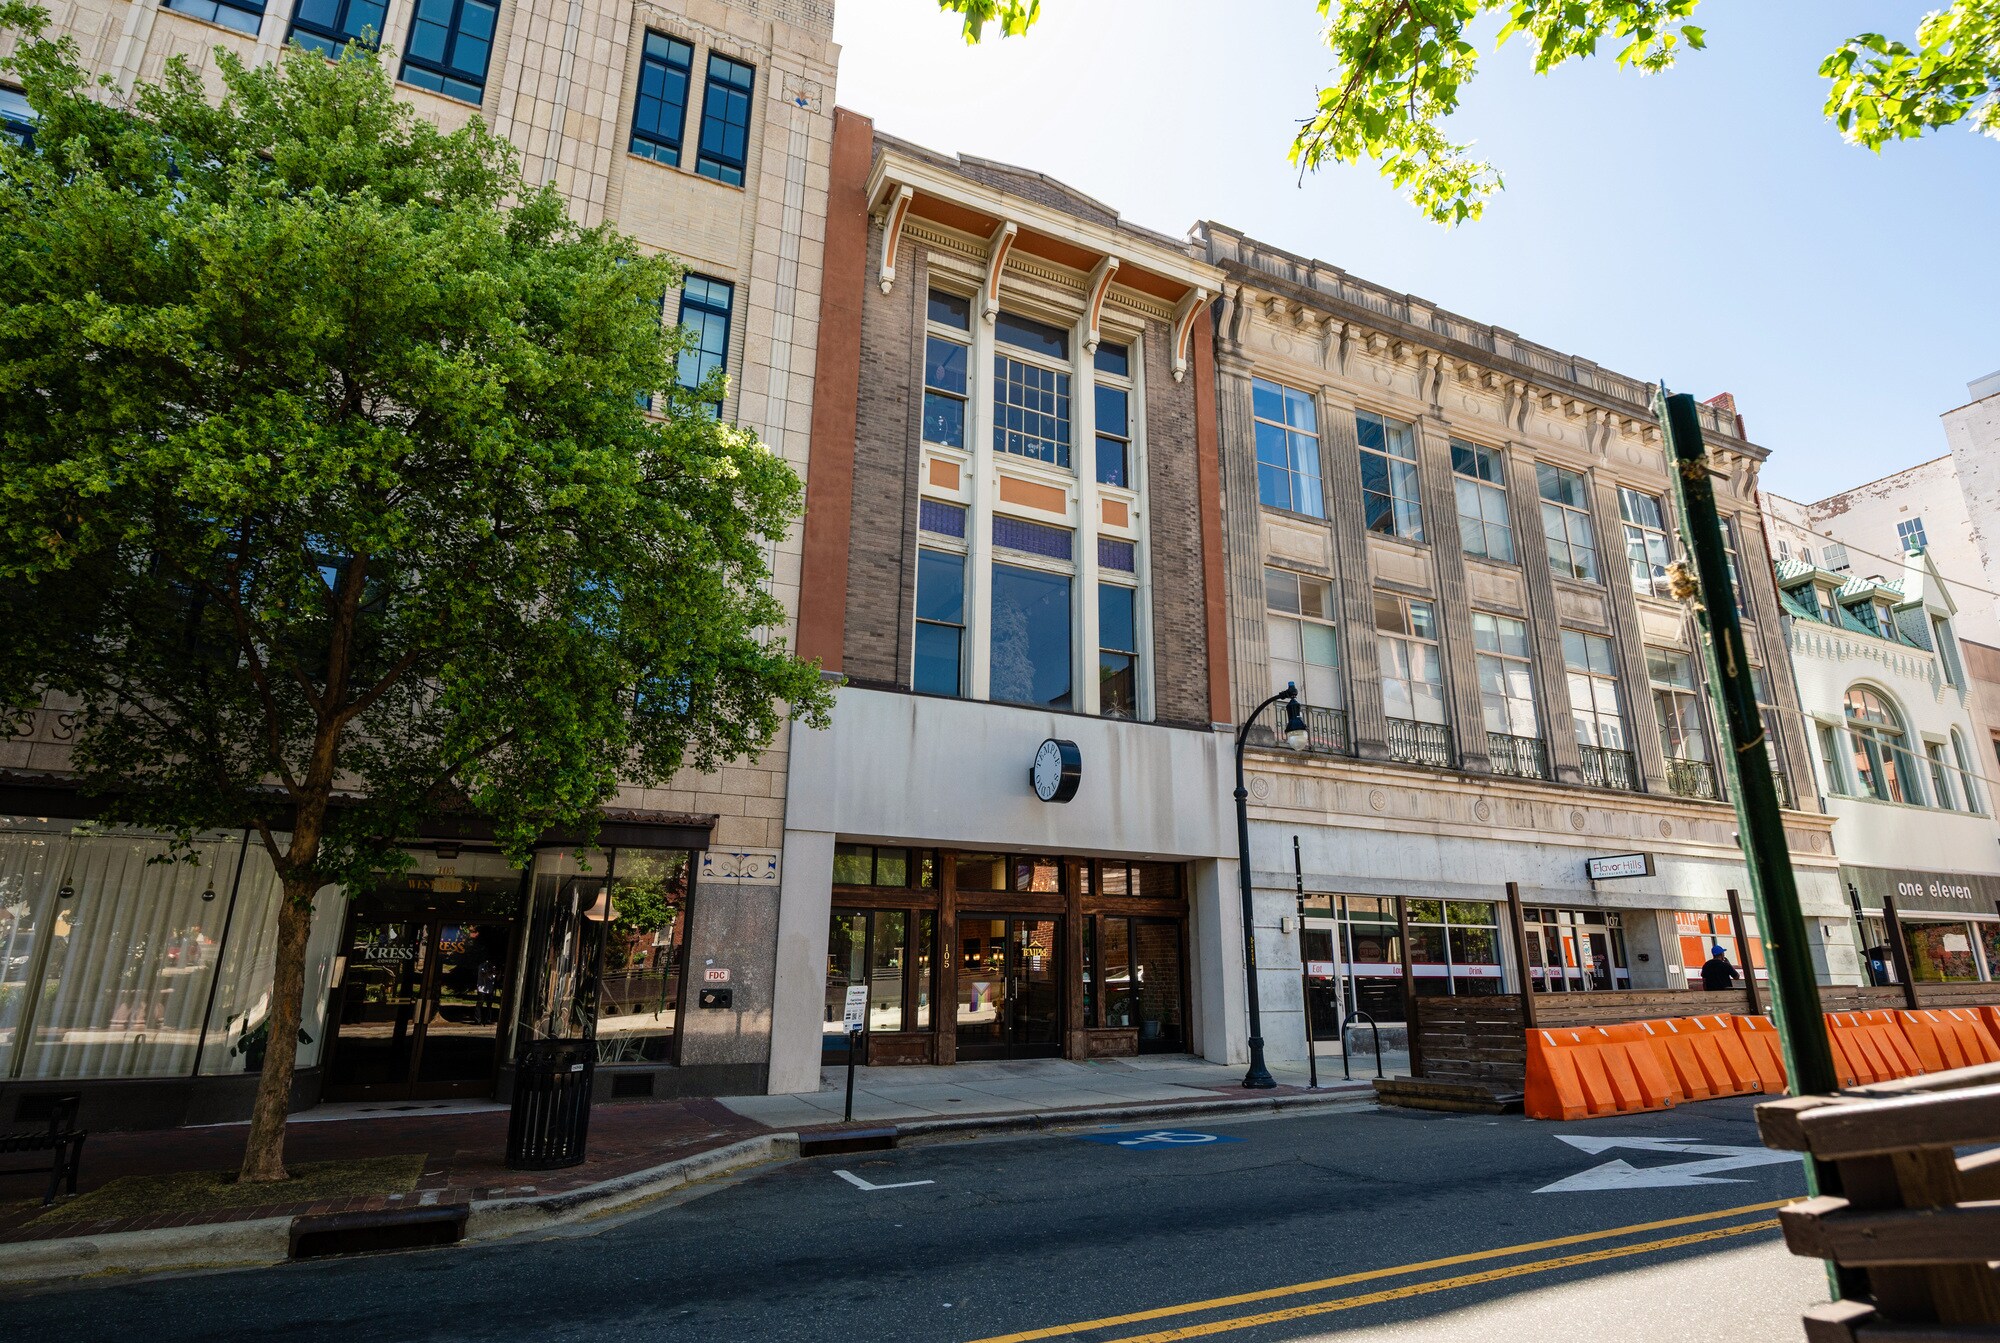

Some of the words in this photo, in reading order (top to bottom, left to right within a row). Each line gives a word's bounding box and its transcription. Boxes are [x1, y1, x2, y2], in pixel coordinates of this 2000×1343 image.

[1036, 743, 1061, 769] TEMPLE
[1035, 772, 1060, 797] STUDIO
[438, 866, 454, 876] 103
[1593, 861, 1621, 872] Flavor
[1623, 860, 1642, 870] Hills
[408, 879, 435, 890] WEST
[1898, 882, 1924, 897] one
[1929, 880, 1972, 899] eleven
[364, 947, 414, 960] KRESS
[1312, 964, 1323, 973] Eat
[1873, 960, 1881, 970] P
[709, 971, 725, 979] FDC
[1469, 967, 1483, 975] Drink
